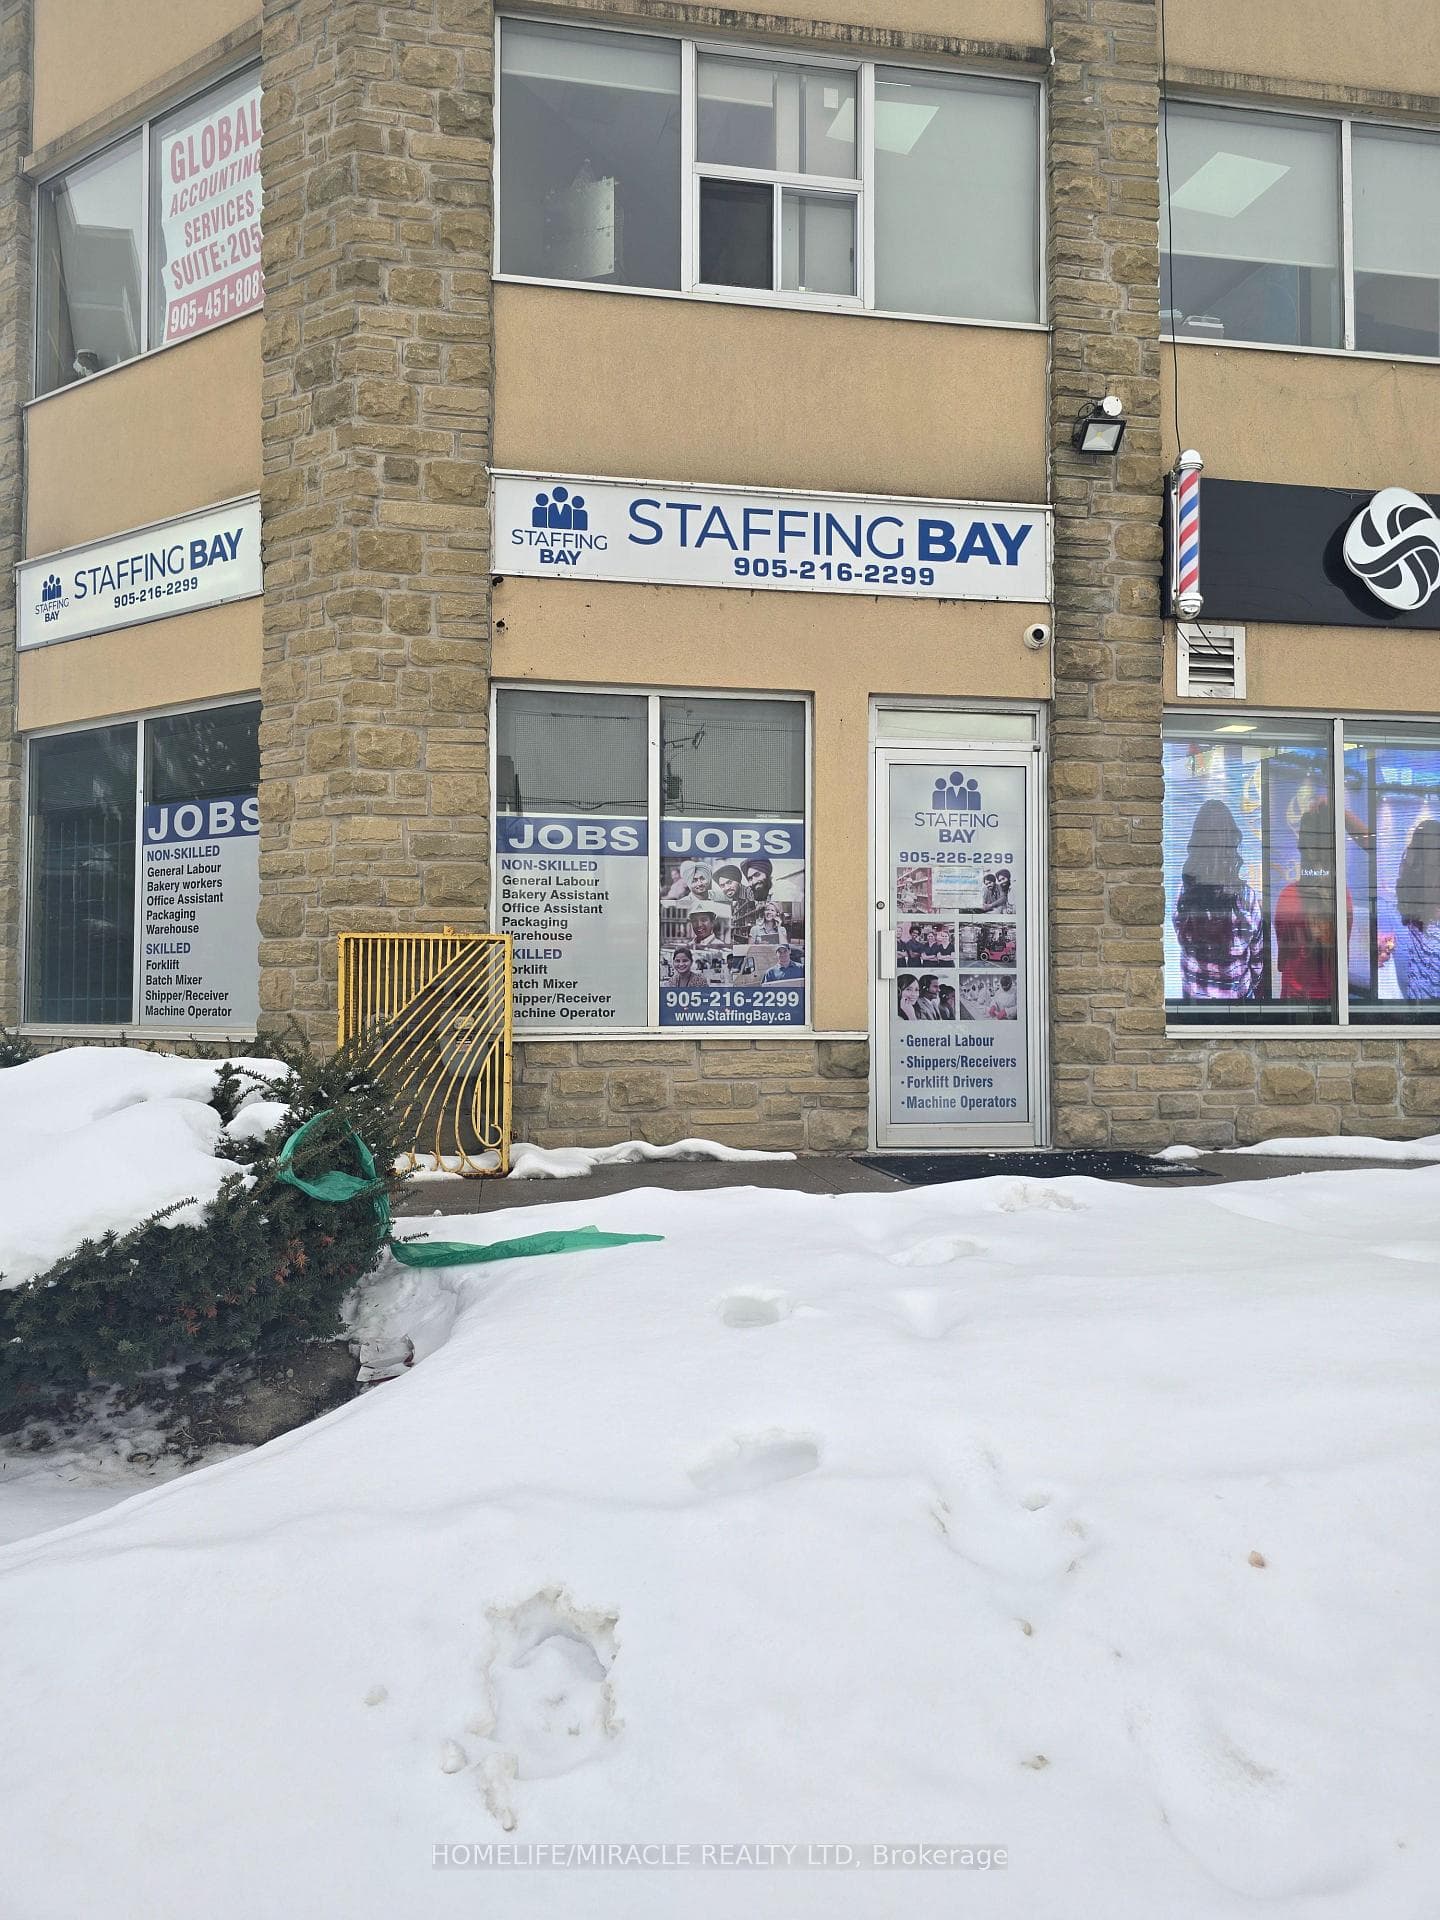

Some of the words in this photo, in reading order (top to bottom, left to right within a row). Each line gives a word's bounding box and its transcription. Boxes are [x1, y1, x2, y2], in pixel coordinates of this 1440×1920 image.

[170, 99, 263, 184] GLOBAL
[184, 189, 255, 248] SERVICES
[170, 271, 265, 334] 905-451-808
[627, 497, 905, 560] STAFFING
[918, 518, 1034, 566] BAY
[511, 528, 608, 551] STAFFING
[74, 545, 184, 600] STAFFING
[190, 528, 244, 571] BAY
[540, 548, 582, 567] BAY
[734, 556, 936, 587] 905-216-2299
[114, 577, 198, 609] 905-216-2299
[35, 597, 70, 616] STAFFING
[44, 610, 60, 623] BAY
[147, 797, 260, 842] JOBS
[914, 811, 999, 829] STAFFING
[508, 824, 639, 851] JOBS
[667, 828, 792, 855] JOBS
[938, 829, 977, 843] BAY
[146, 844, 220, 863] NON-SKILLED
[899, 851, 1014, 864] 905-226-2299
[147, 865, 184, 878] General
[186, 863, 222, 876] Labour
[501, 859, 598, 872] NON-SKILLED
[147, 879, 180, 893] Bakery
[182, 878, 223, 890] workers
[502, 875, 553, 886] General
[555, 876, 600, 887] Labour
[146, 894, 175, 906] Office
[177, 892, 224, 904] Assistant
[502, 889, 547, 902] Bakery
[550, 890, 609, 901] Assistant
[501, 903, 540, 914] Office
[543, 903, 603, 914] Assistant
[146, 909, 196, 923] Packaging
[501, 916, 568, 930] Packaging
[145, 924, 200, 935] Warehouse
[145, 942, 191, 955] SKILLED
[502, 949, 563, 960] KILLED
[145, 959, 180, 970] Forklift
[503, 964, 548, 975] orklift
[145, 974, 173, 986] Batch
[175, 974, 203, 985] Mixer
[503, 979, 539, 989] atch
[543, 979, 578, 989] Mixer
[145, 989, 229, 1003] Shipper/Receiver
[503, 993, 612, 1006] hipper/Receiver
[666, 992, 799, 1008] 905-216-2299
[145, 1004, 185, 1016] Machine
[187, 1005, 232, 1019] Operator
[503, 1008, 556, 1018] achine
[559, 1008, 616, 1020] Operator
[674, 1009, 791, 1023] www.StaffingBay.ca
[906, 1035, 951, 1047] General
[955, 1035, 995, 1047] Labour
[906, 1055, 1017, 1070] Shippers/Receivers
[906, 1076, 950, 1089] Forklift
[953, 1075, 994, 1088] Drivers
[906, 1096, 957, 1109] Machine
[960, 1096, 1017, 1111] Operators
